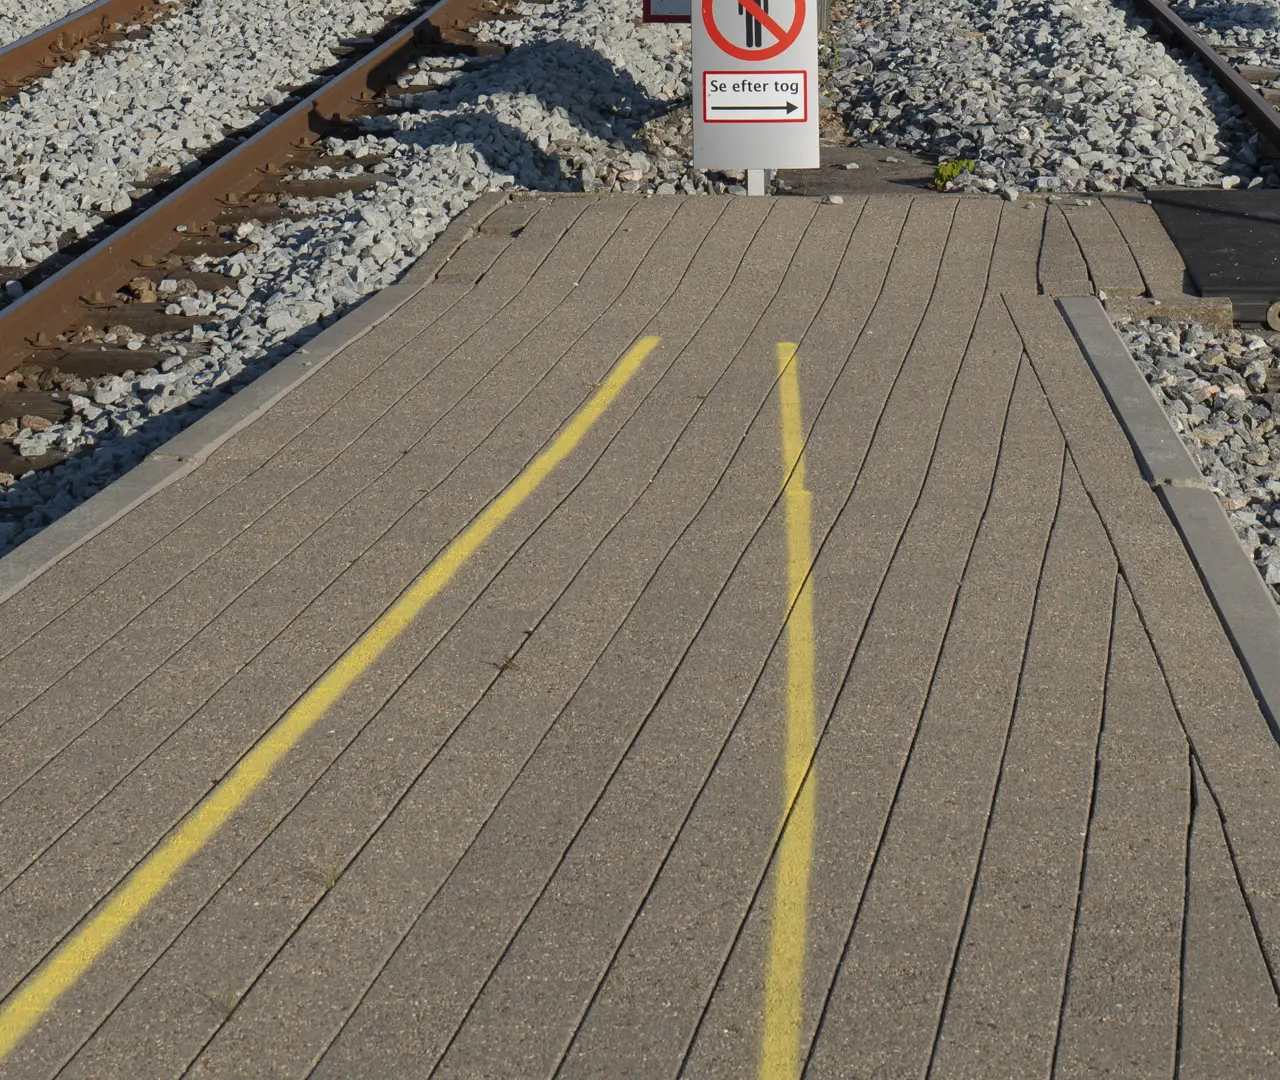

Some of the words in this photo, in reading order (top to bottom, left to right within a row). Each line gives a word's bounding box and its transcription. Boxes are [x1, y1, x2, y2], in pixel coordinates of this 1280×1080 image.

[710, 79, 727, 93] Se
[732, 79, 769, 93] efter
[774, 81, 799, 95] tog
